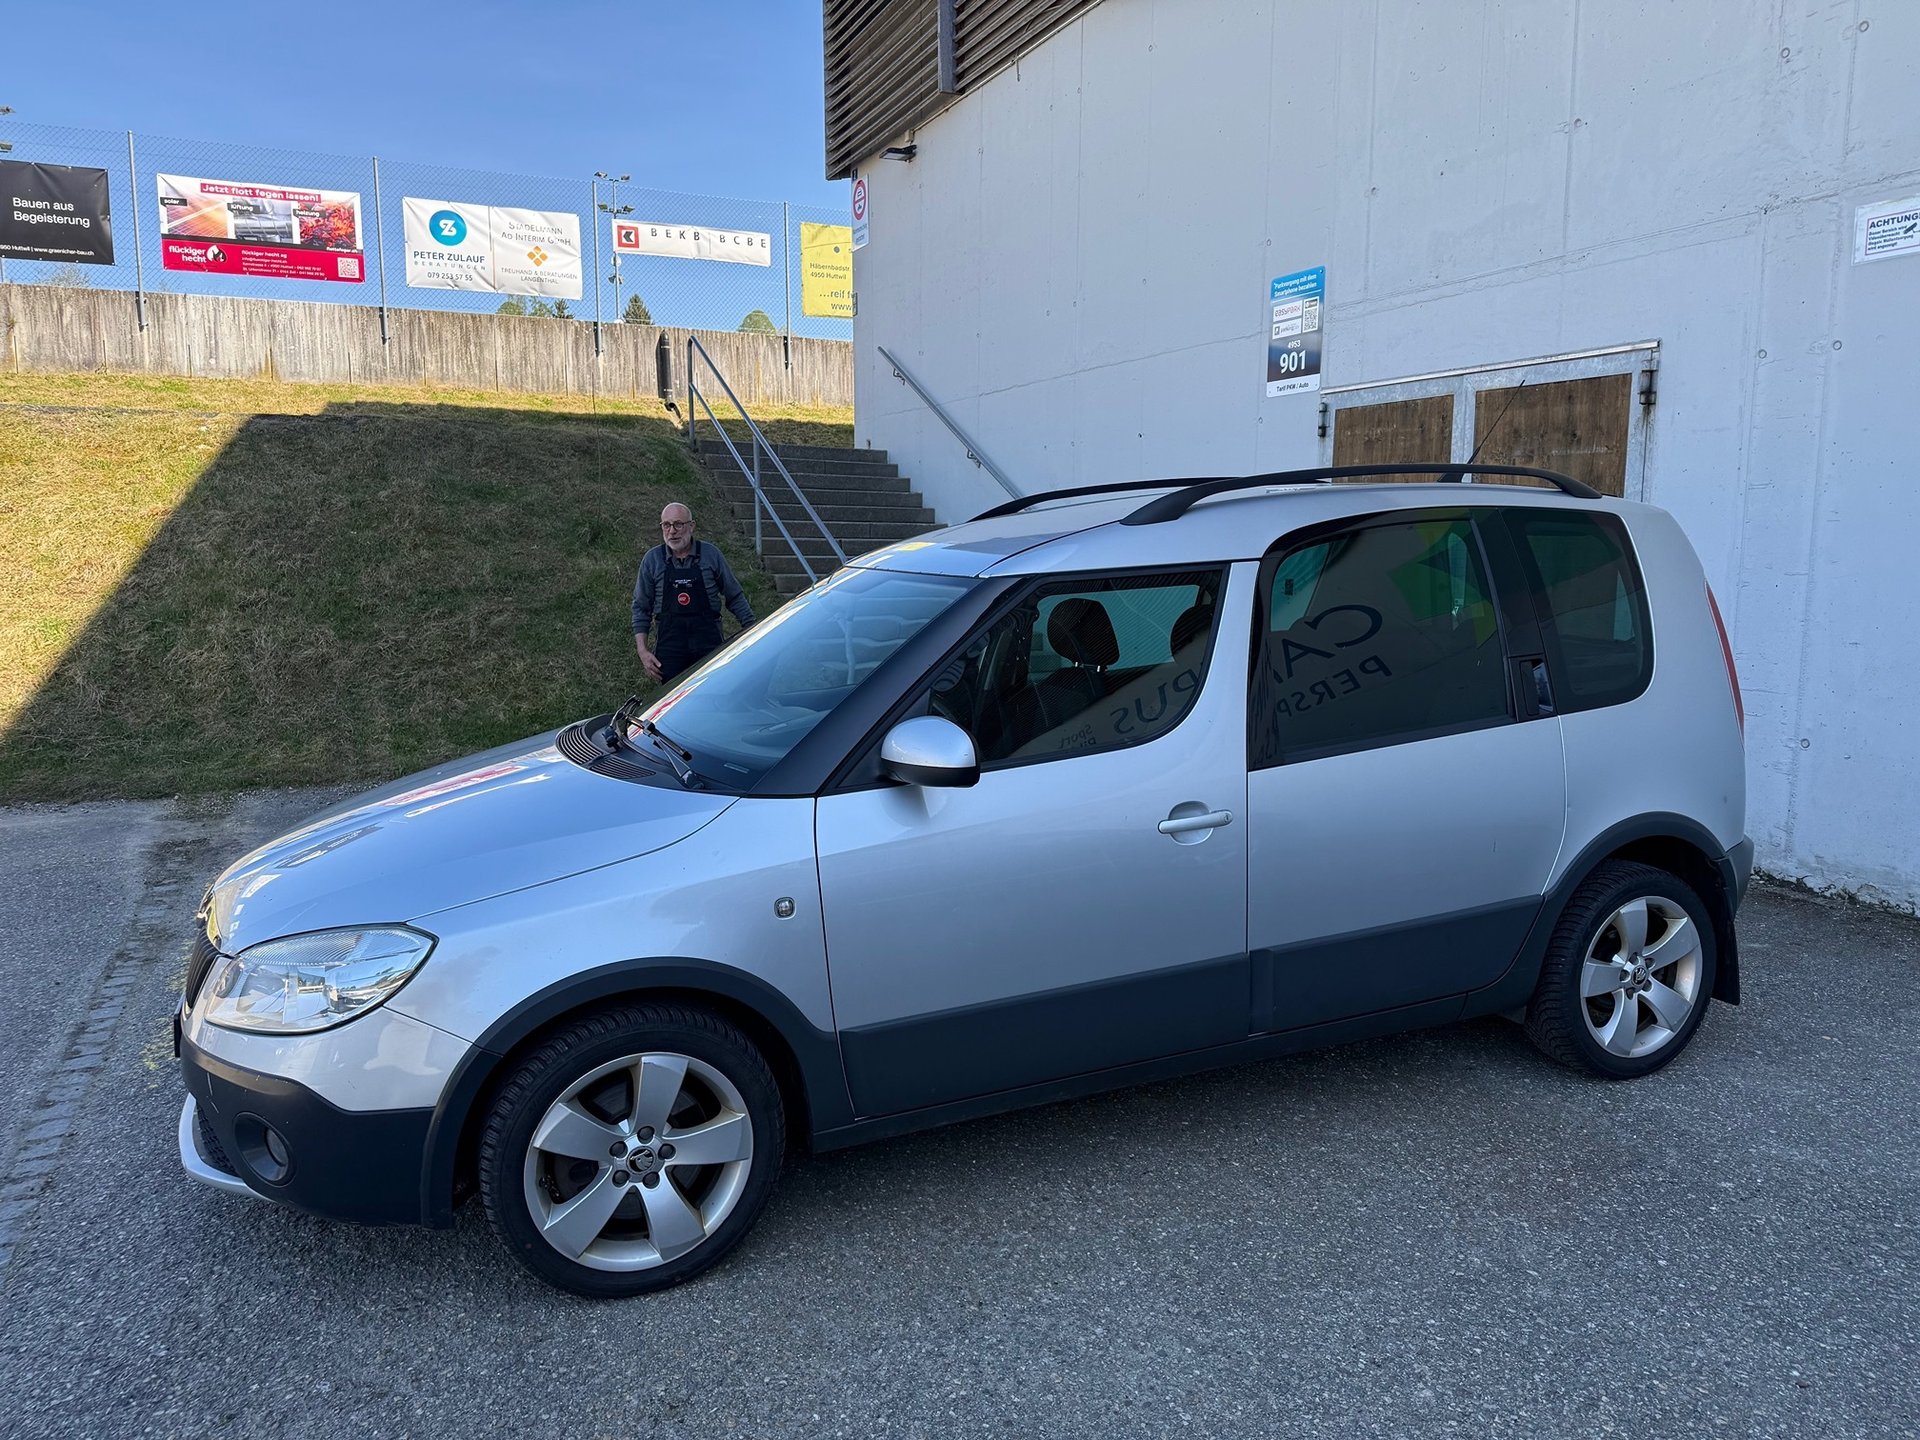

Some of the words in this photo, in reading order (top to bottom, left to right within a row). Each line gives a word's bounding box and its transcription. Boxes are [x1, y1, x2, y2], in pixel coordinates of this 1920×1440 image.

[202, 184, 229, 194] Jetzt
[231, 187, 254, 196] flott
[255, 189, 284, 199] fegen
[285, 191, 319, 202] lassen!
[12, 197, 51, 210] Bauen
[53, 200, 74, 212] aus
[230, 204, 254, 212] lüftung
[295, 209, 320, 218] heizung
[14, 211, 91, 228] Begeisterung
[547, 236, 572, 246] GH
[650, 227, 700, 241] BEKB
[719, 234, 766, 249] BCBE
[168, 245, 206, 256] flückiger
[181, 254, 207, 263] hecht
[413, 250, 445, 261] PETER
[447, 253, 485, 263] ZULAUF
[414, 260, 486, 271] BERATUNGEN
[427, 271, 440, 279] 079
[441, 272, 454, 280] 253
[455, 273, 463, 281] 57
[1280, 350, 1306, 374] 901
